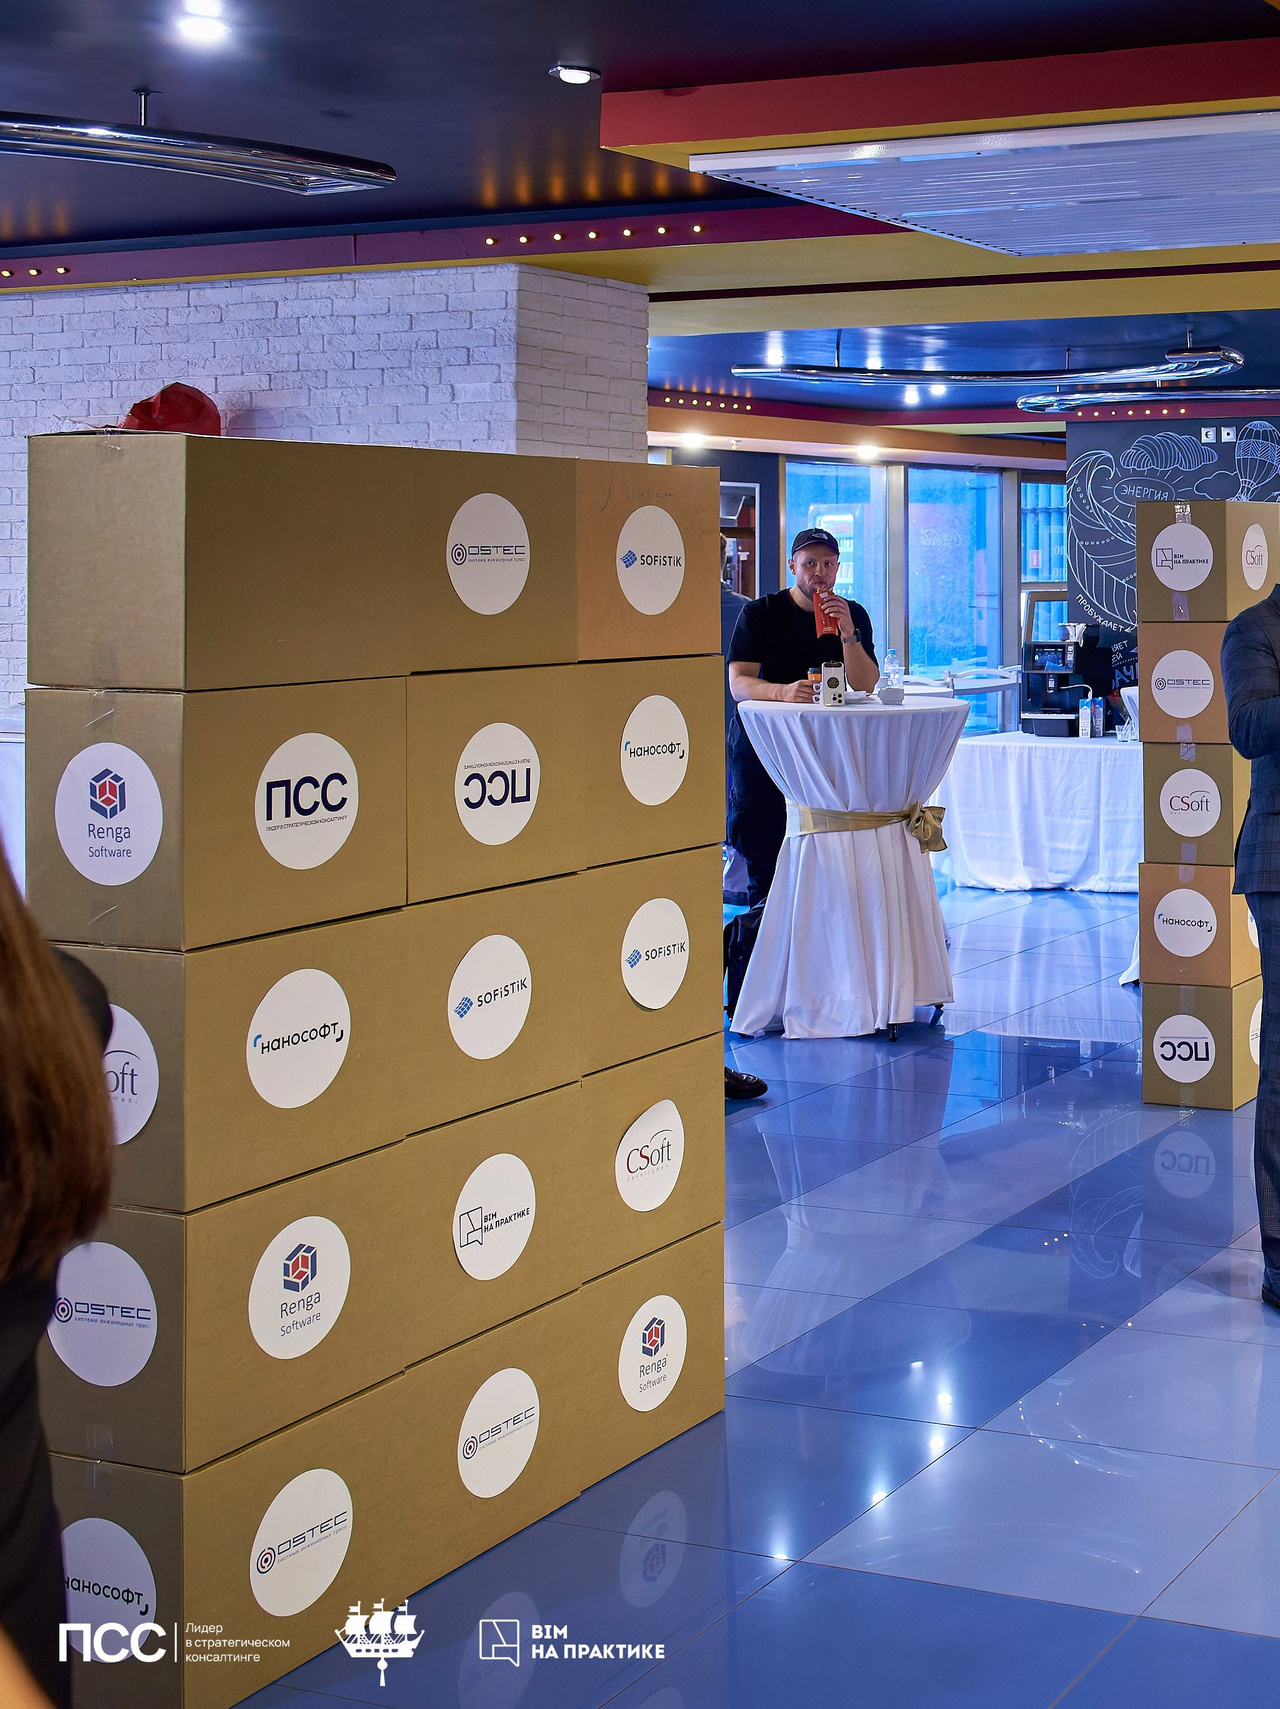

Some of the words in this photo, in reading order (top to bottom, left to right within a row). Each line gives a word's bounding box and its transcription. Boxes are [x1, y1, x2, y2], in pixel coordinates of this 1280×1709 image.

[1120, 484, 1169, 501] ЭНЕРГИЯ
[468, 545, 526, 555] OSTEC
[1076, 594, 1125, 633] ПРОБУЖДАЕТ
[629, 741, 682, 758] нанософт
[266, 772, 348, 821] ПСС
[1169, 795, 1210, 812] CSoft
[88, 823, 131, 843] Renga
[88, 846, 132, 858] Software
[1162, 917, 1210, 929] нанософт
[261, 1021, 340, 1055] нанософт
[626, 1137, 672, 1174] CSoft
[484, 1210, 497, 1224] BIM
[484, 1224, 494, 1234] НА
[495, 1207, 530, 1229] ПРАКТИКЕ
[74, 1301, 151, 1321] OSTEC
[280, 1291, 321, 1319] Renga
[280, 1311, 322, 1337] Software
[639, 1356, 667, 1378] Renga
[639, 1373, 667, 1393] Software
[478, 1405, 536, 1444] OSTEC
[277, 1510, 348, 1556] OSTEC
